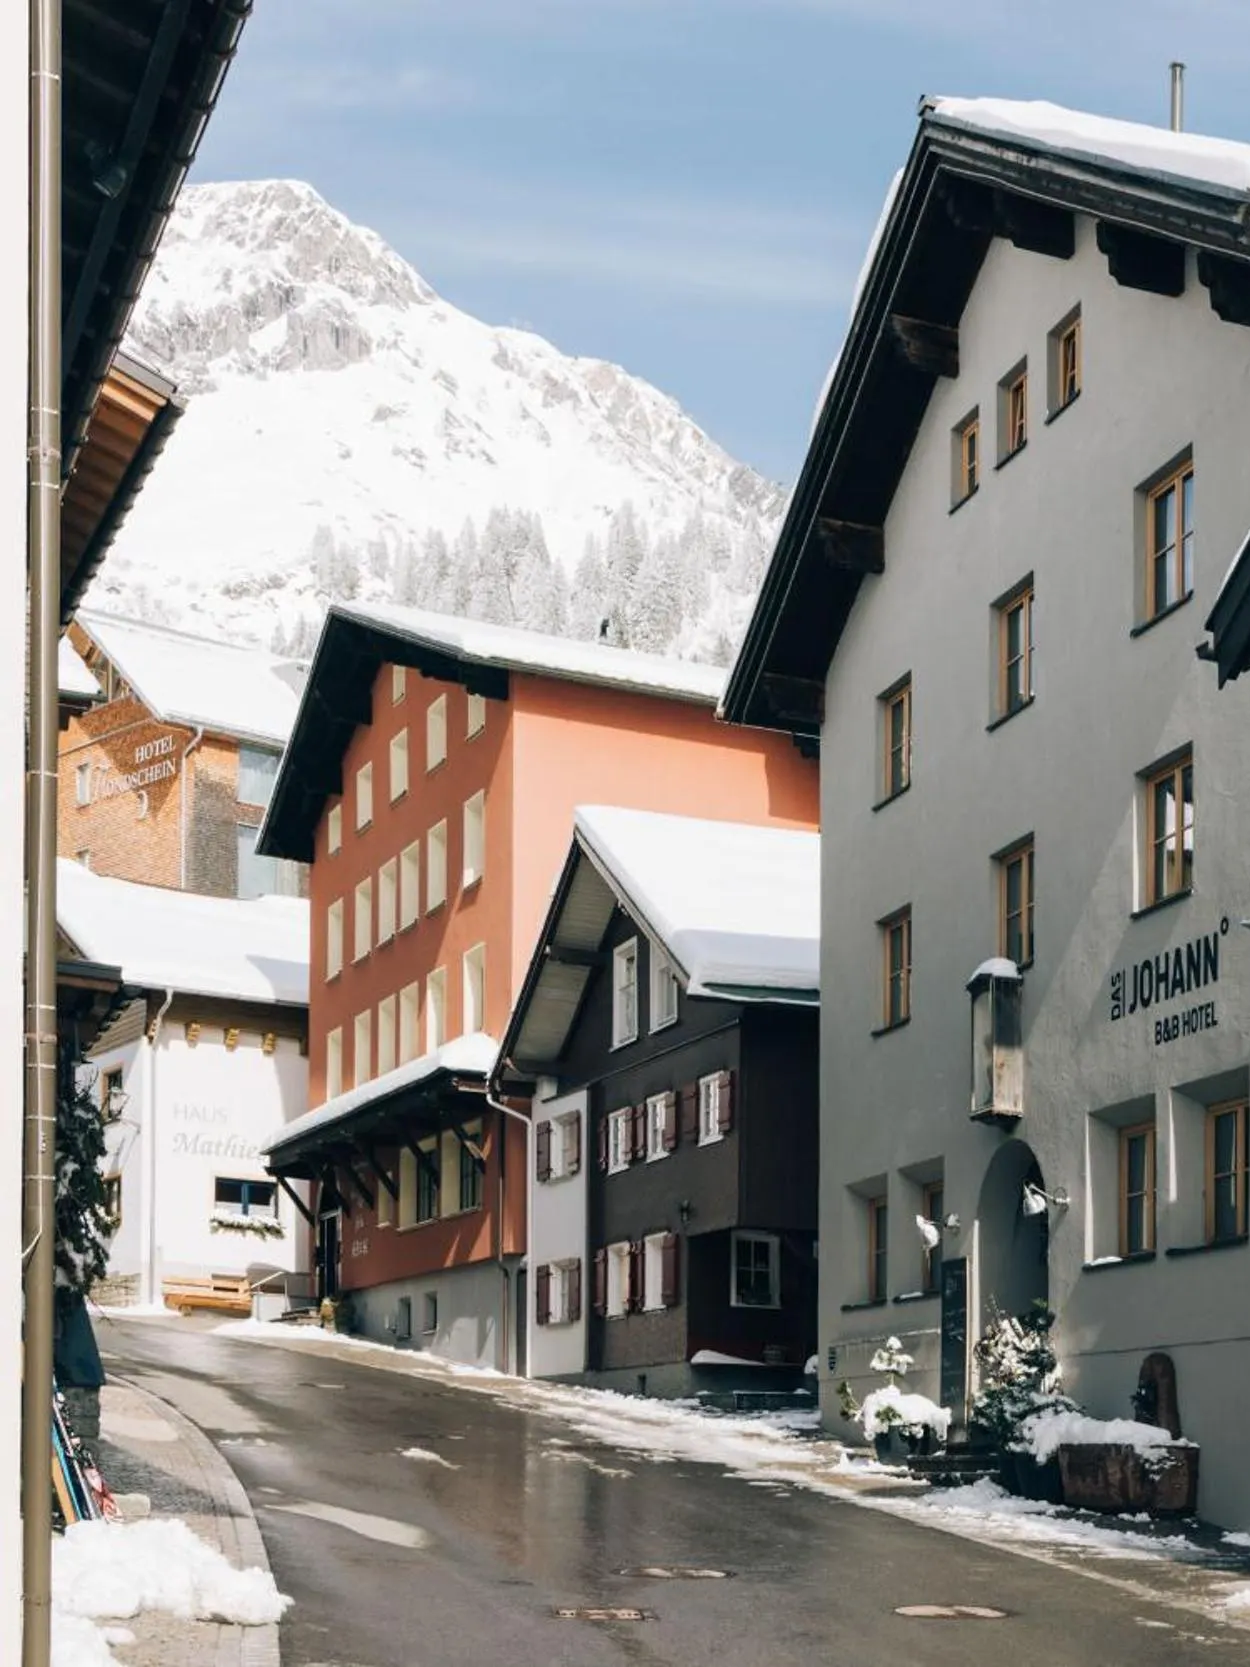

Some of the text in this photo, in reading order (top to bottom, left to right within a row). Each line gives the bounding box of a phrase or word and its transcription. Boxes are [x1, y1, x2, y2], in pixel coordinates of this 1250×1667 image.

[135, 734, 177, 763] HOTEL
[1111, 972, 1121, 1021] DAS
[1155, 1001, 1218, 1045] B&B HOTEL
[173, 1102, 228, 1124] HAUS
